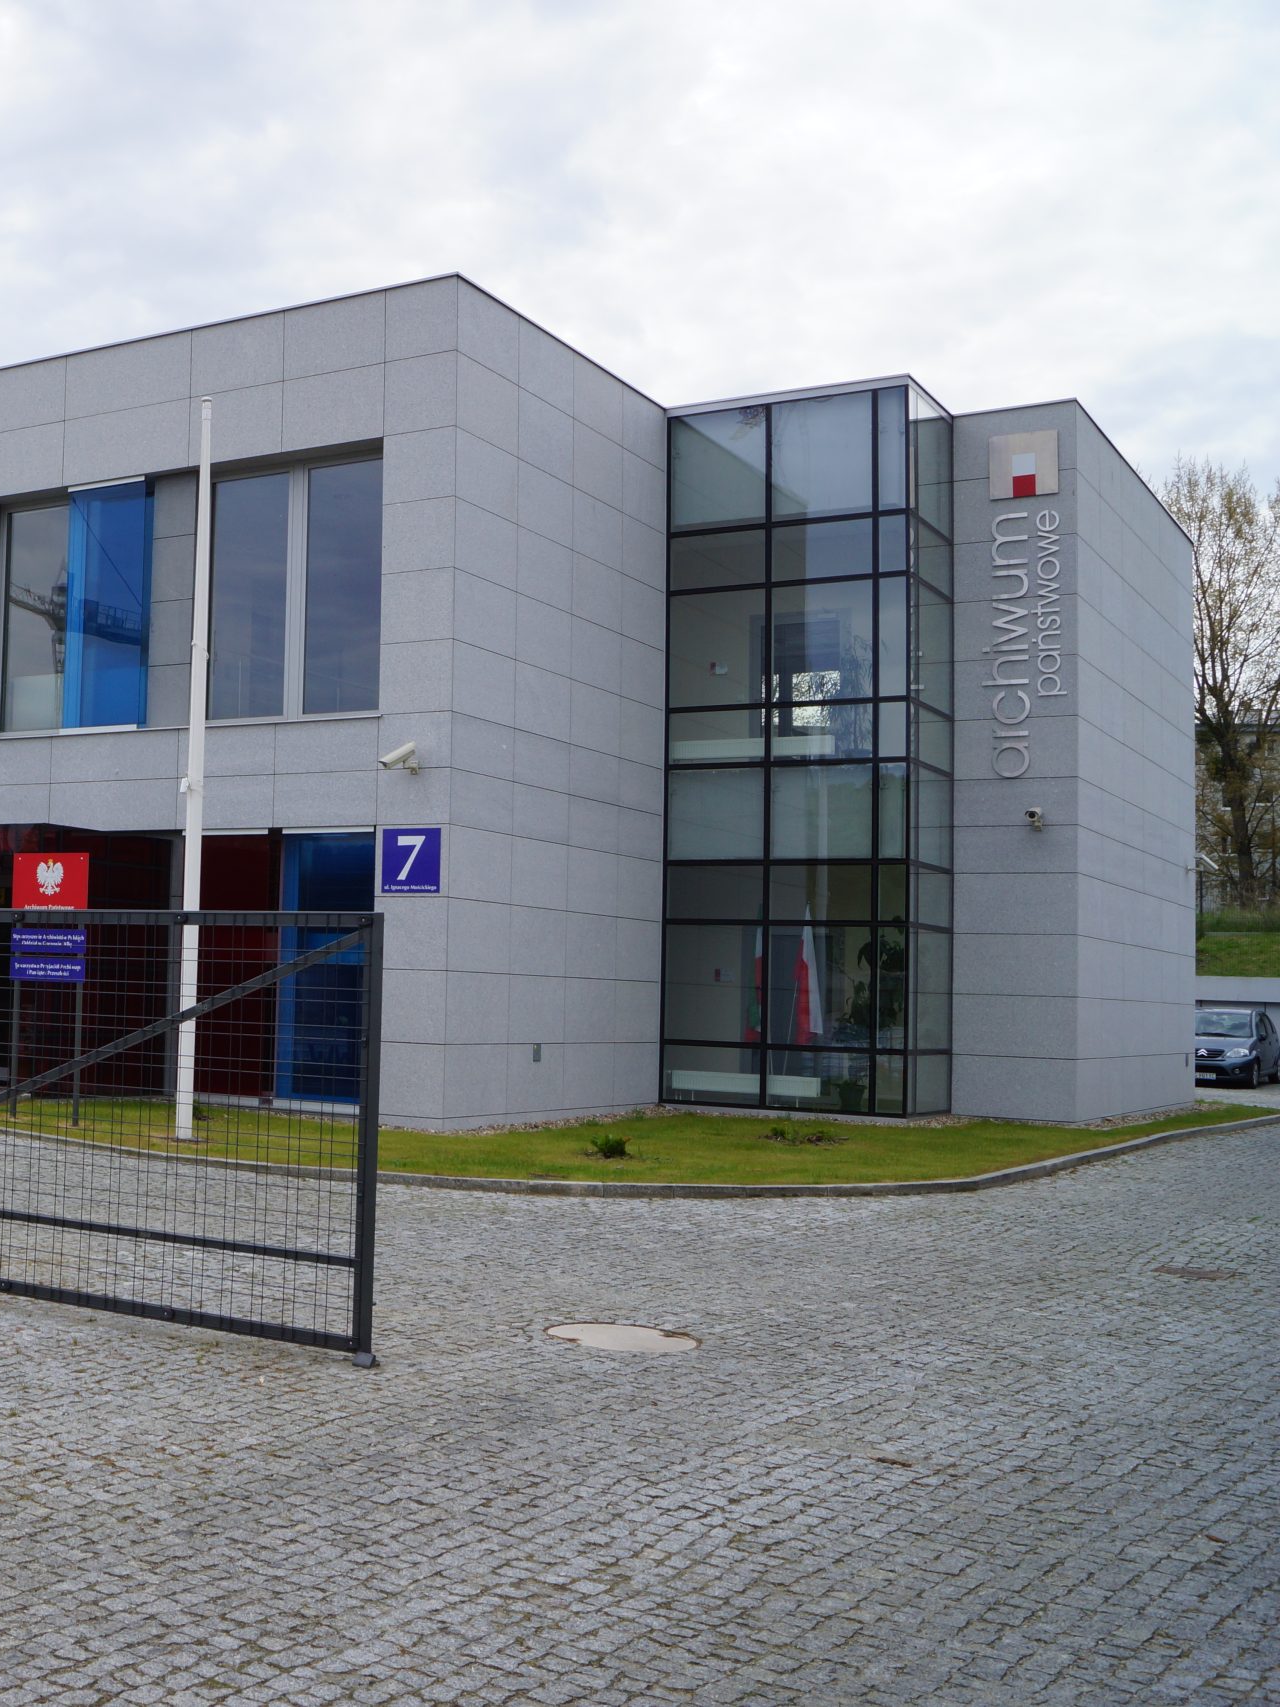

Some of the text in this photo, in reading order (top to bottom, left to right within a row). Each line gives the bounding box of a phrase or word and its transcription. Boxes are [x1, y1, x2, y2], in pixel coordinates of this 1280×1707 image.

[981, 511, 1031, 779] archiwum
[1031, 509, 1067, 698] państwowe
[397, 836, 425, 880] 7
